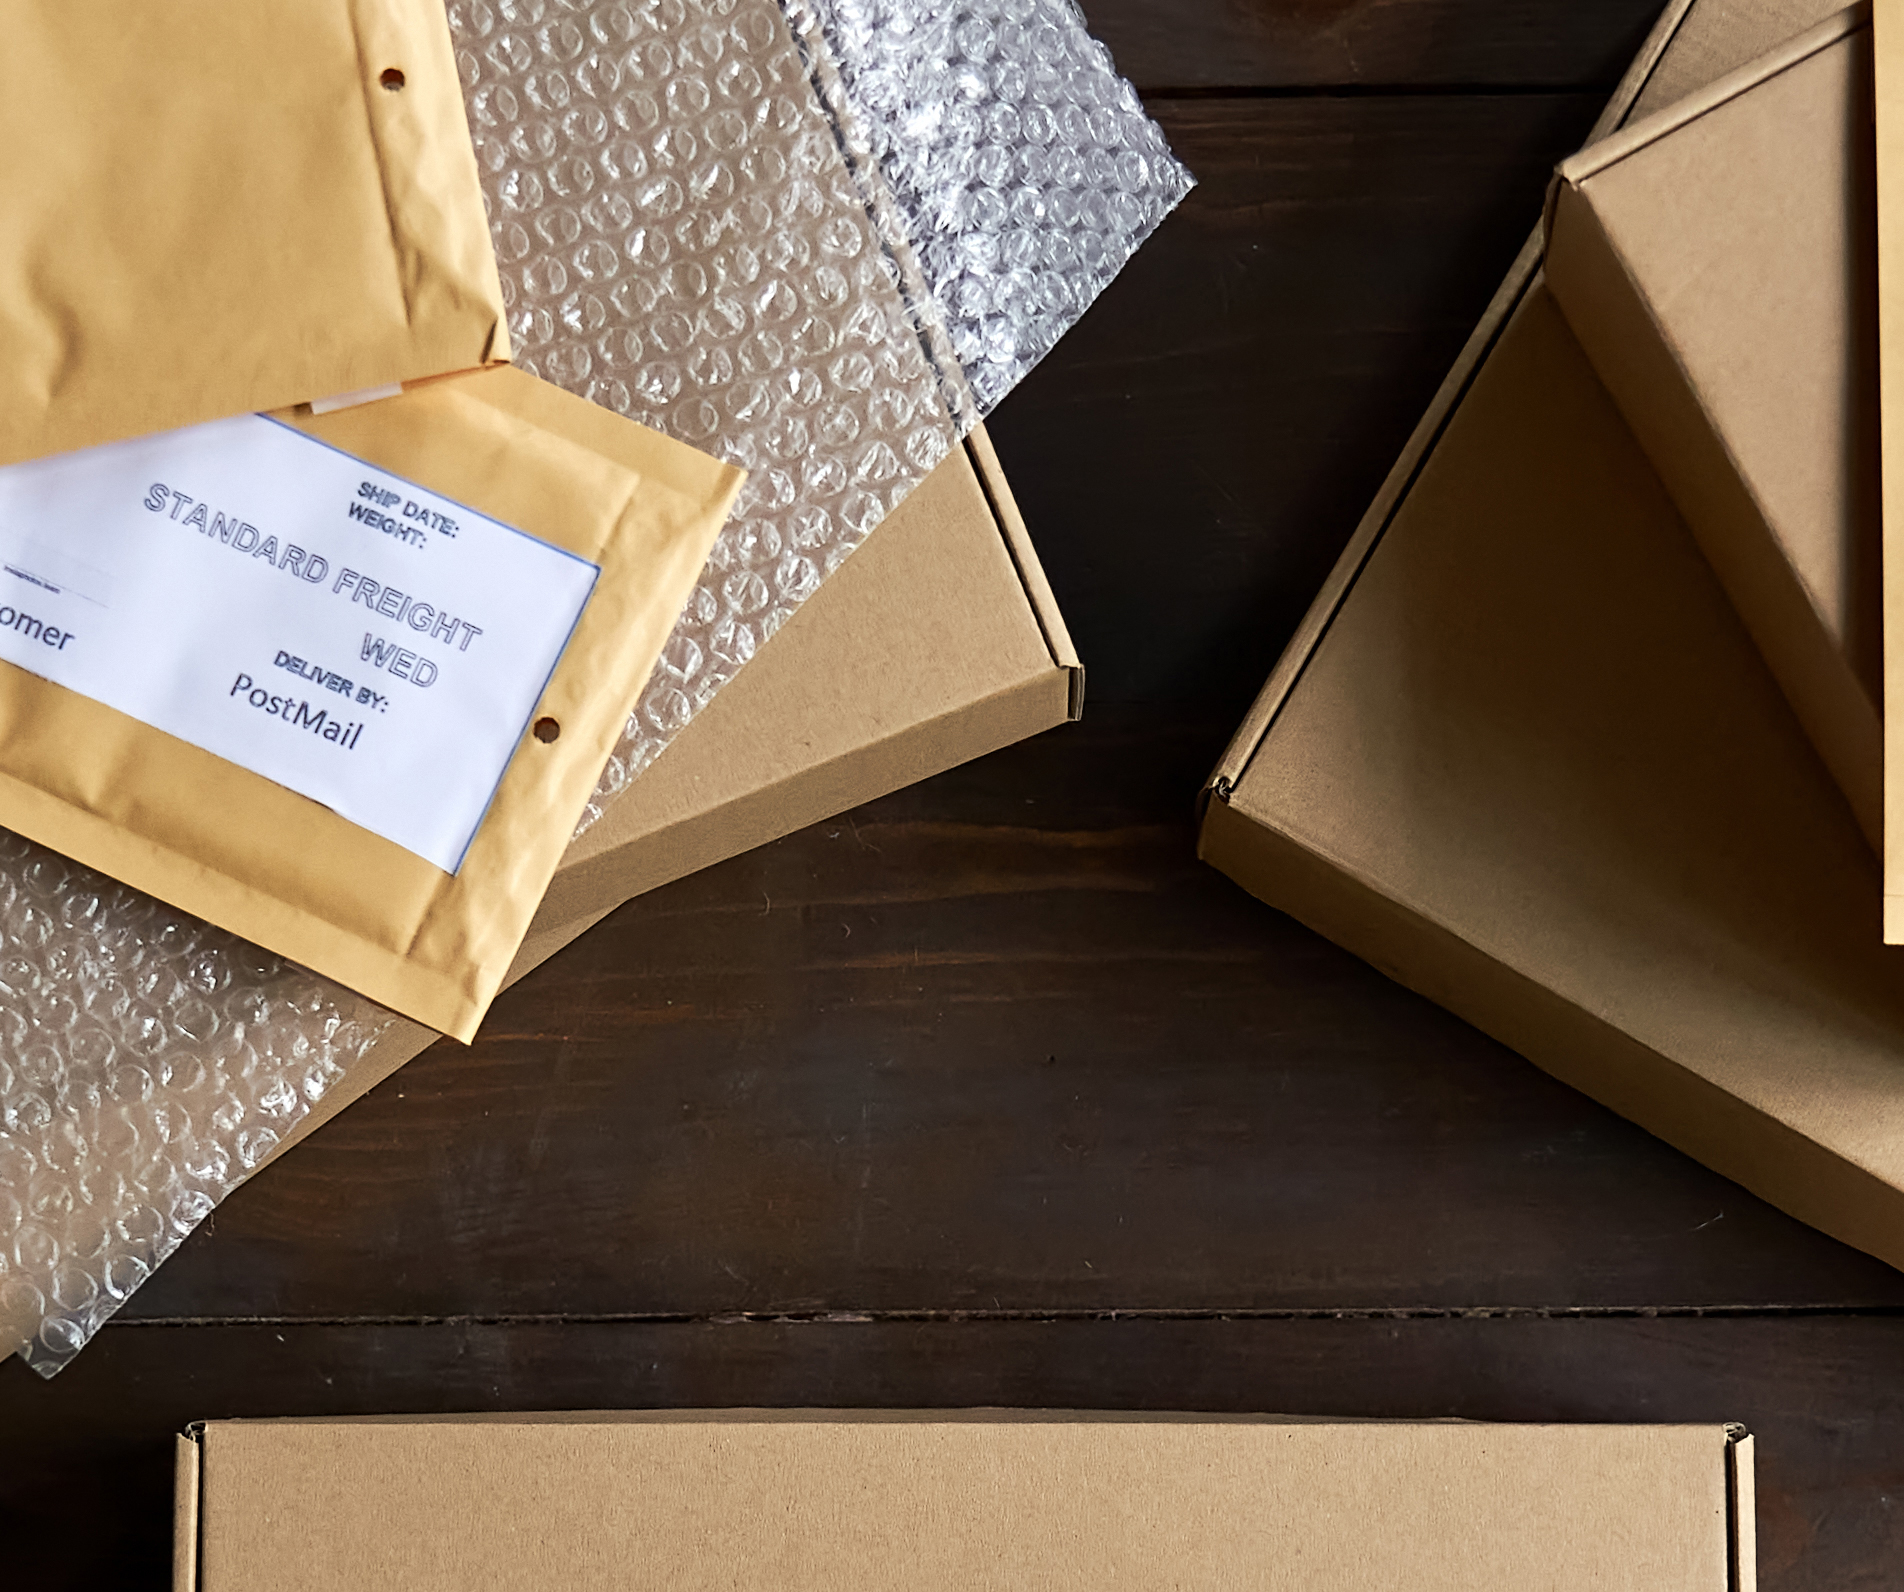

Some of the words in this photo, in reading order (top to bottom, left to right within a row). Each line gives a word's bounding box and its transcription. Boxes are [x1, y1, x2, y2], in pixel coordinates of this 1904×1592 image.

[348, 502, 427, 549] WEIGHT:
[357, 481, 401, 514] SHIP
[402, 498, 460, 539] DATE:
[143, 483, 329, 583] STANDARD
[332, 567, 483, 652] FREIGHT
[273, 650, 356, 706] DELIVER
[358, 683, 390, 714] BY:
[360, 632, 438, 688] WED
[230, 673, 364, 750] PostMail
